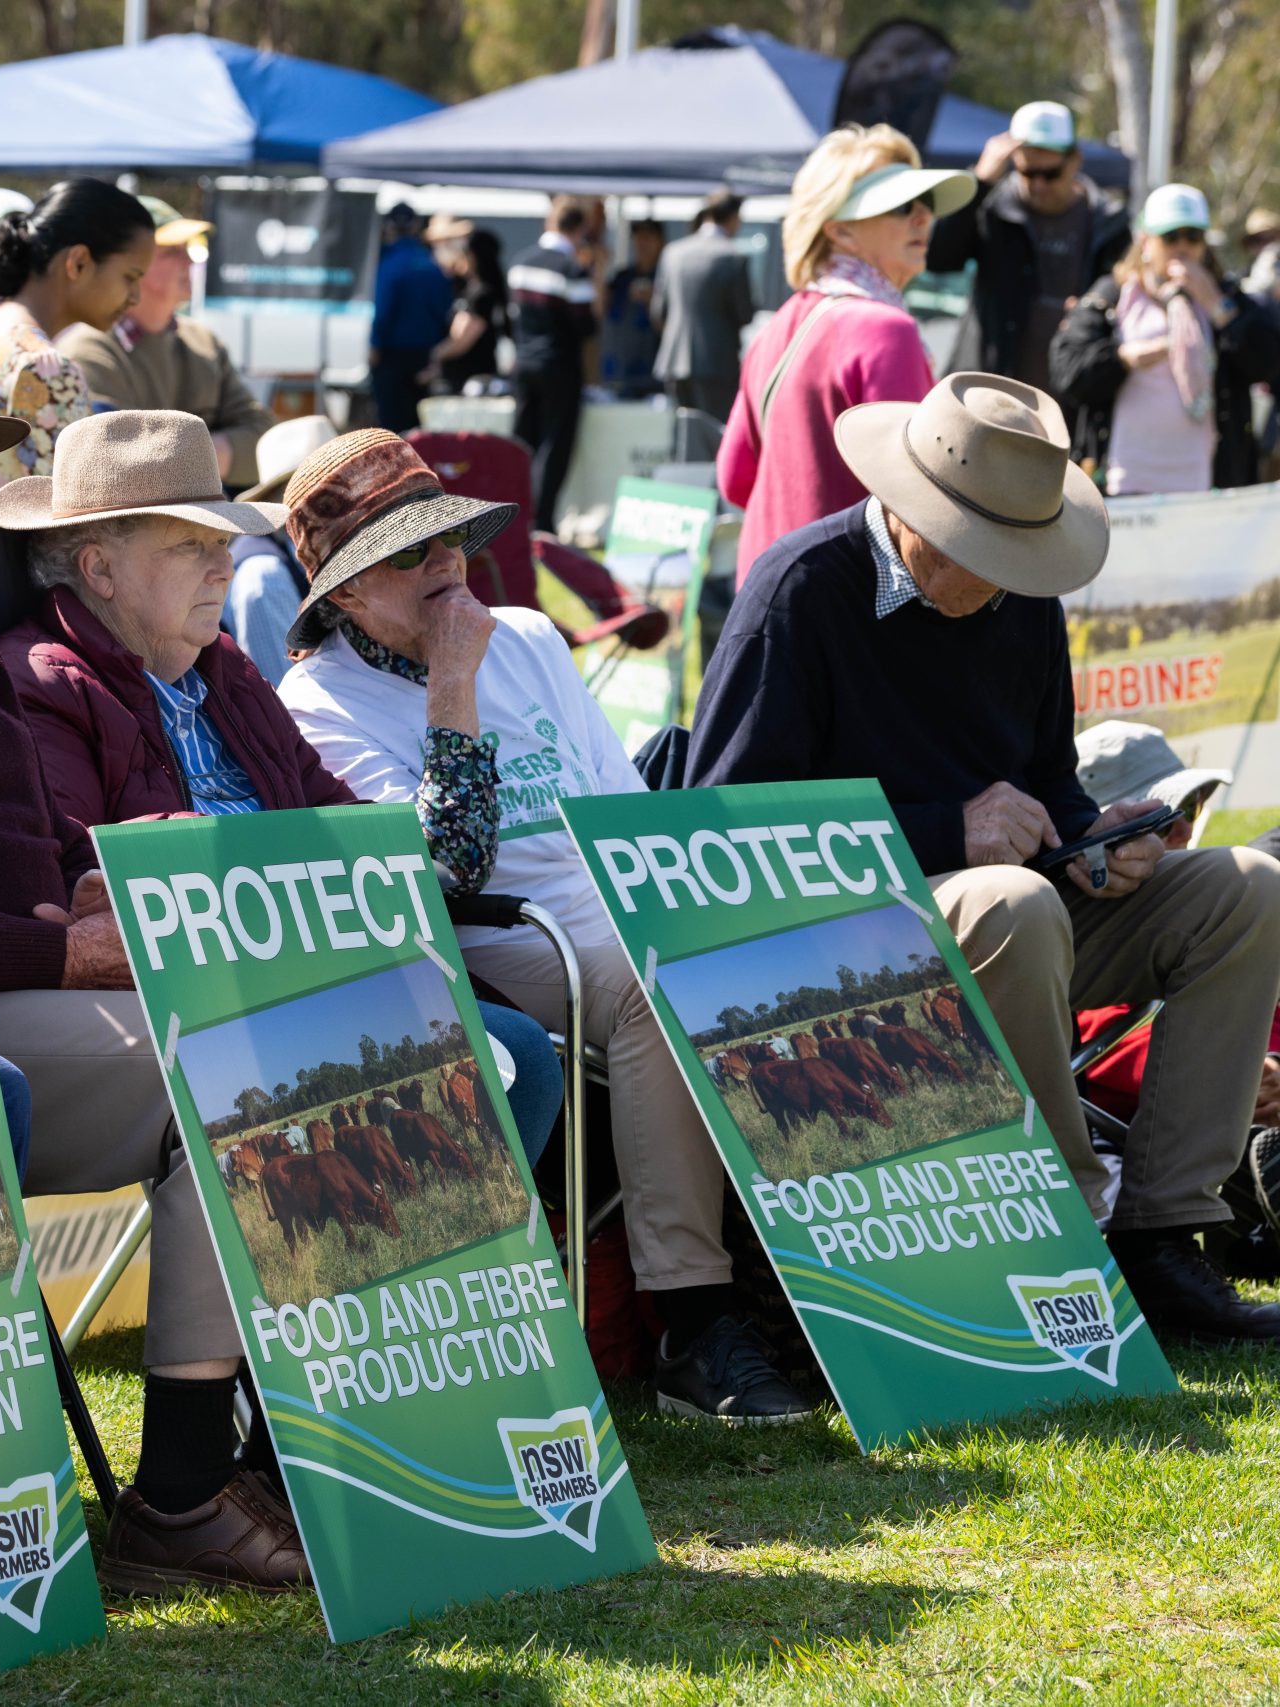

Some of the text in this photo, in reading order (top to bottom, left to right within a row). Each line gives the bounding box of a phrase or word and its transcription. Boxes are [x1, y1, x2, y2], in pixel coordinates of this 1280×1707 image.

[1073, 654, 1222, 713] URBINES
[593, 820, 908, 913] PROTECT
[125, 853, 435, 971] PROTECT
[750, 1147, 1070, 1227] FOOD AND FIBRE
[807, 1195, 1063, 1268] PRODUCTION
[250, 1258, 567, 1363] FOOD AND FIBRE
[1048, 1323, 1114, 1347] FARMERS
[303, 1318, 555, 1414] PRODUCTION
[532, 1473, 597, 1507] FARMERS
